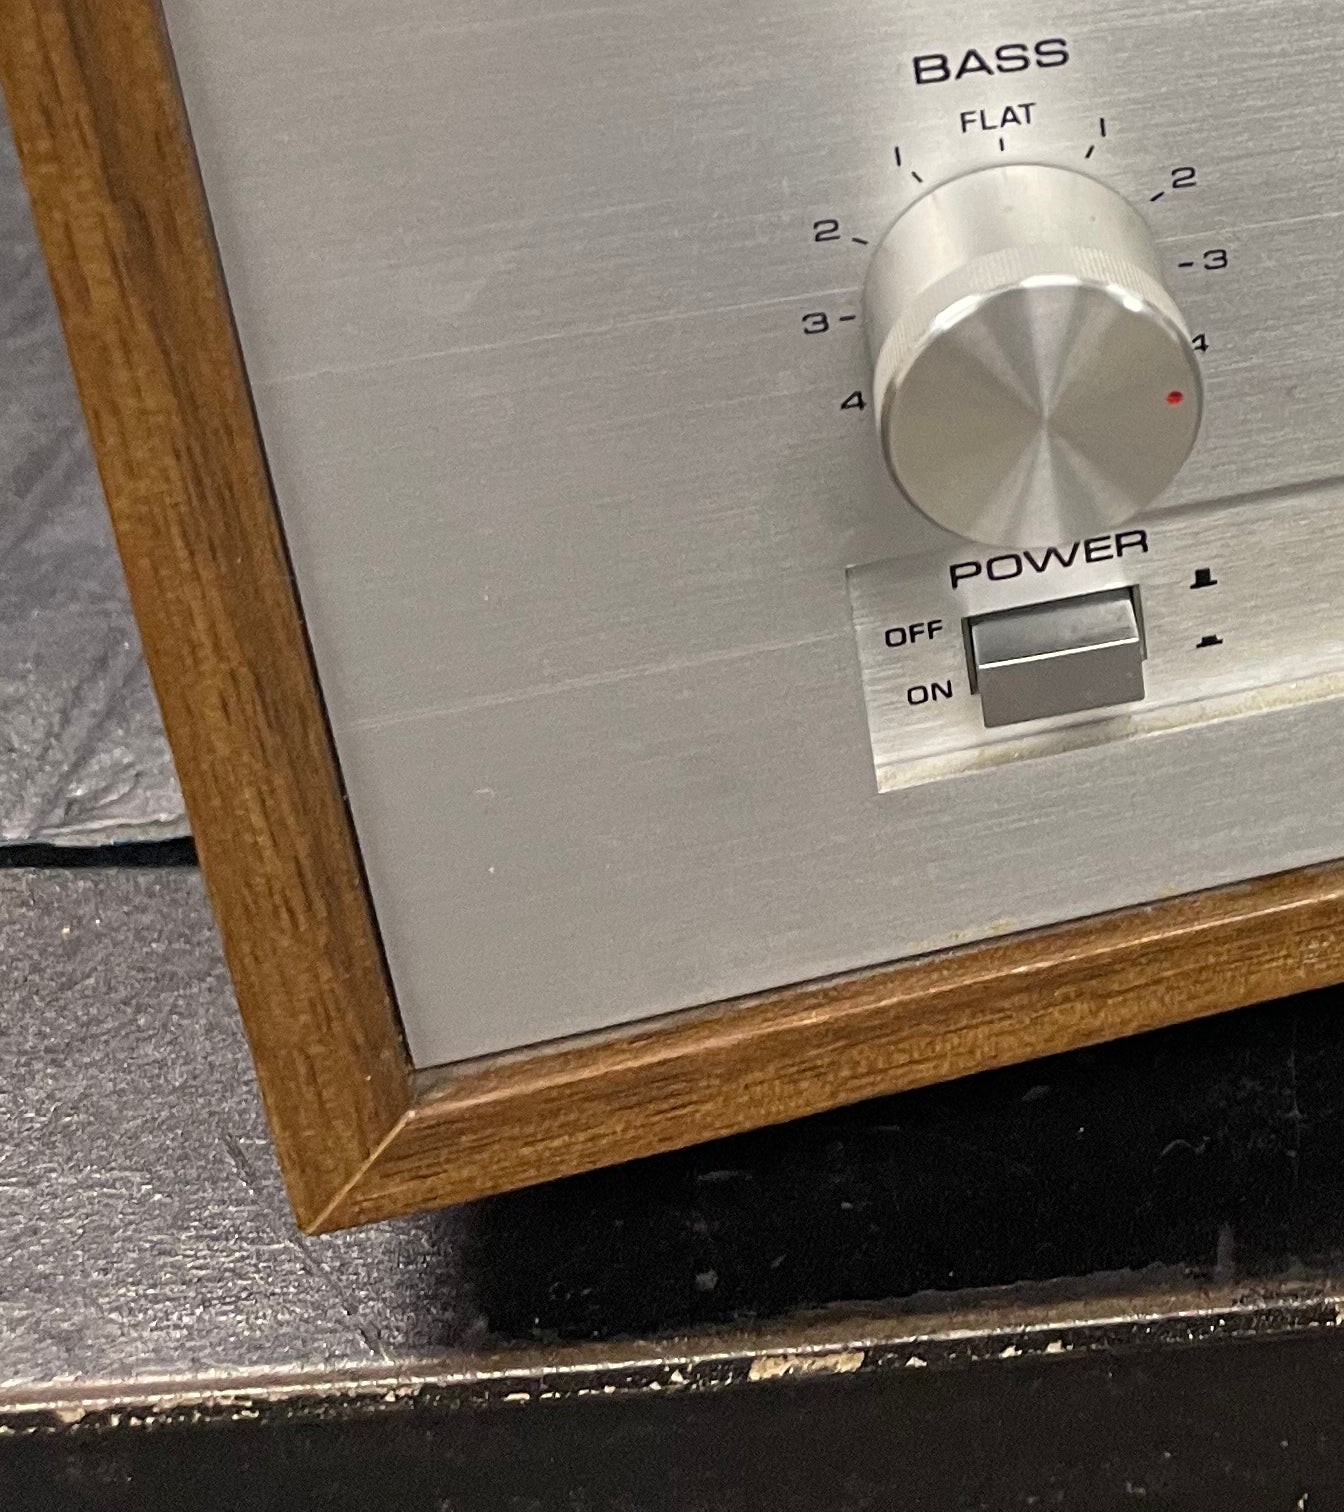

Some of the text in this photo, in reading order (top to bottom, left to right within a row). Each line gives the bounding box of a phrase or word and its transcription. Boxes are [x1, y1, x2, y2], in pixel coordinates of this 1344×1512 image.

[912, 38, 1070, 85] BASS
[960, 102, 1036, 134] FLAT
[1171, 166, 1197, 189] 2
[813, 219, 841, 243] 2
[1203, 249, 1228, 271] 3
[801, 312, 830, 335] 3
[840, 391, 866, 411] 4
[949, 529, 1149, 589] POWER
[884, 619, 943, 648] OFF
[907, 679, 953, 706] ON
